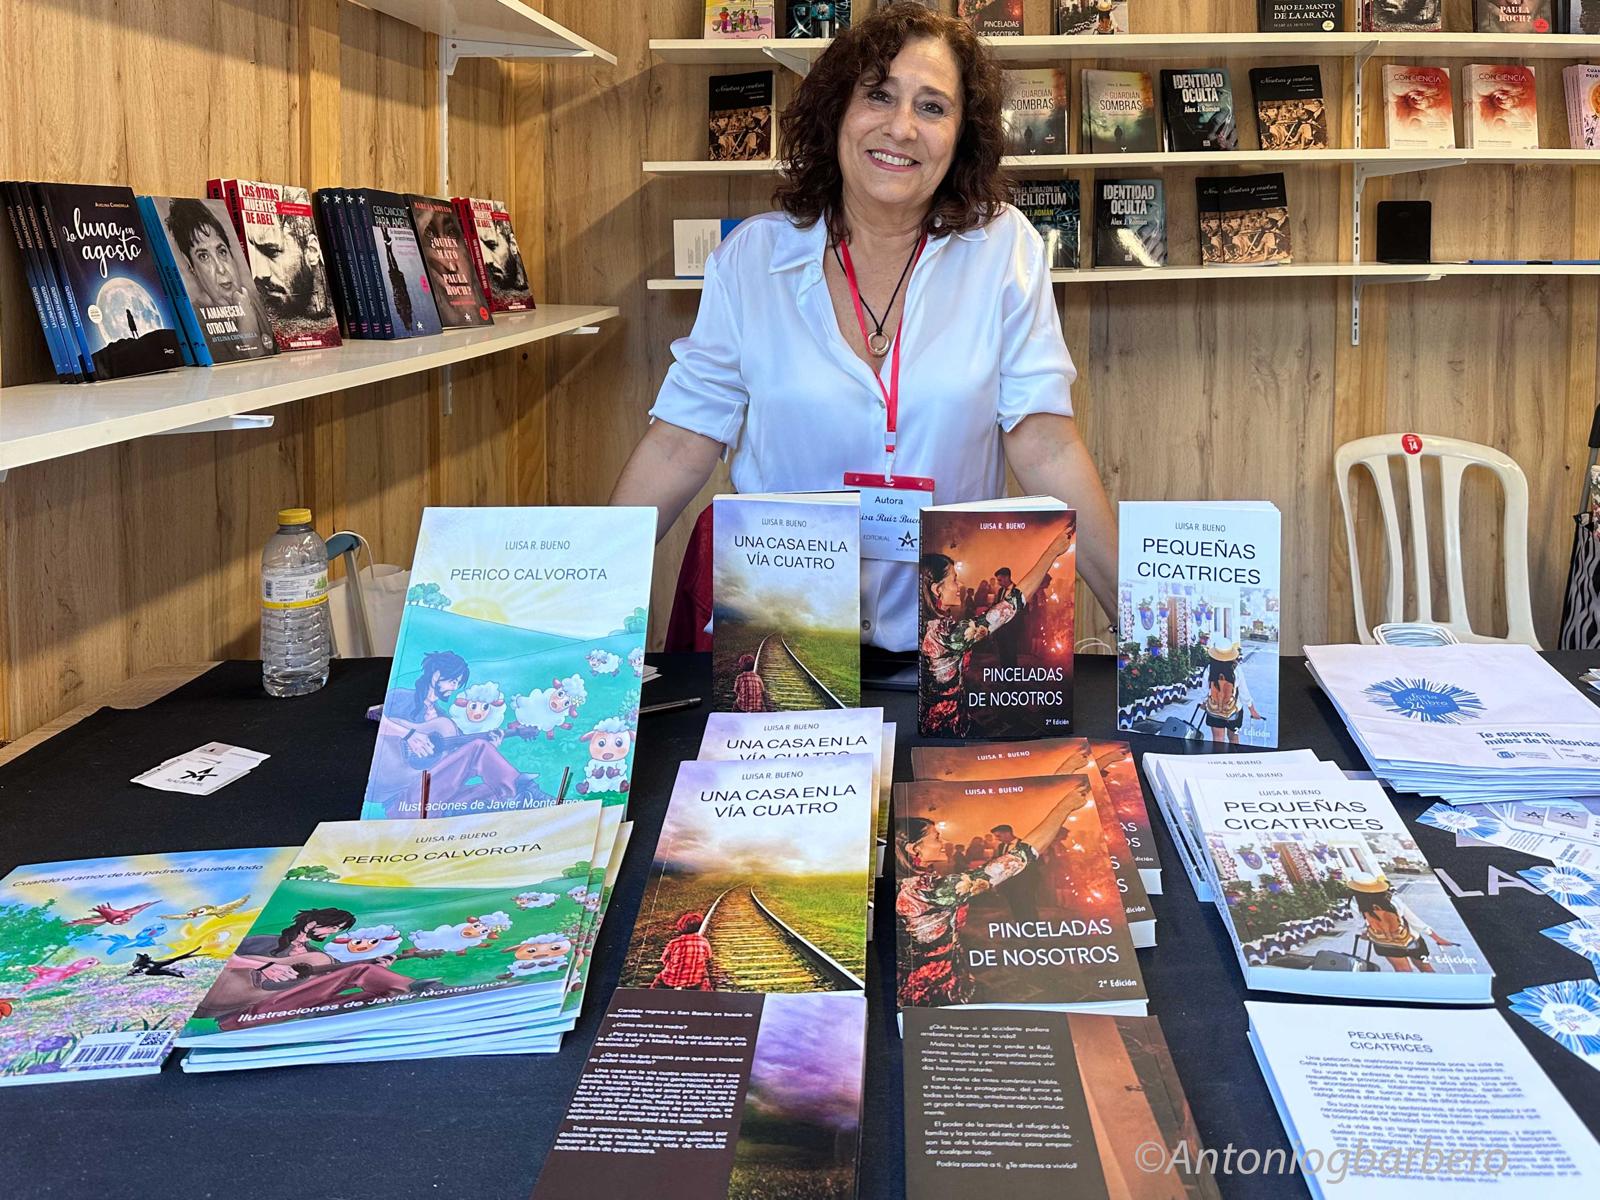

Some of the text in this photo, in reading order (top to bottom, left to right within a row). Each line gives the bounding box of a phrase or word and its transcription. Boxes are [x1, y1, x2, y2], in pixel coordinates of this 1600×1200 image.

[1274, 12, 1287, 20] DE
[1302, 10, 1335, 19] ARAÑA
[1172, 73, 1223, 89] IDENTIDAD
[1394, 72, 1441, 83] CONCIENCIA
[1479, 72, 1527, 83] CONCIENCIA
[1021, 88, 1053, 98] GUARDIÁN
[1109, 90, 1140, 99] GUARDIÁN
[1182, 88, 1218, 103] OCULTA
[1011, 98, 1054, 111] SOMBRAS
[1100, 99, 1143, 111] SOMBRAS
[241, 185, 279, 200] LAS OTRAS
[1014, 192, 1066, 206] HEILIGTUM
[1104, 185, 1154, 200] IDENTIDAD
[244, 198, 277, 212] MUERTES
[1111, 200, 1147, 215] OCULTA
[74, 208, 122, 240] luna
[245, 212, 274, 225] DE ABEL
[431, 236, 458, 249] ¿QUIÉN
[82, 230, 141, 278] agosto
[437, 249, 458, 259] MATÓ
[443, 274, 468, 284] PAULA
[200, 302, 246, 319] Y AMANECERÁ
[206, 318, 238, 334] OTRO DÍA
[874, 496, 903, 504] Autora
[786, 520, 807, 528] BUENO
[876, 513, 897, 522] Ruiz
[899, 515, 920, 524] Buen
[979, 522, 997, 530] LUISA
[1175, 522, 1194, 530] LUISA
[1202, 523, 1226, 532] BUENO
[505, 540, 570, 550] LUISA R. BUENO
[734, 535, 848, 552] UNA CASA EN LA
[1143, 538, 1256, 560] PEQUEÑAS
[747, 552, 835, 570] VÍA CUATRO
[450, 567, 608, 581] PERICO CALVOROTA
[1137, 562, 1261, 585] CICATRICES
[983, 667, 1064, 682] PINCELADAS
[968, 691, 1063, 707] DE NOSOTROS
[763, 724, 784, 732] LUISA
[1244, 728, 1270, 738] Edición
[726, 735, 868, 749] UNA CASA EN LA
[1542, 738, 1600, 747] historias
[1007, 750, 1030, 758] BUENO
[741, 772, 765, 781] LUISA
[775, 771, 804, 779] BUENO
[700, 784, 857, 802] UNA CASA EN LA
[964, 787, 987, 796] LUISA
[998, 786, 1023, 794] BUENO
[398, 799, 468, 812] Ilustaciones
[470, 799, 485, 810] de
[487, 798, 521, 811] Javier
[714, 801, 838, 818] VÍA CUATRO
[1223, 799, 1367, 814] PEQUEÑAS
[1224, 817, 1384, 831] CICATRICES
[415, 835, 445, 844] LUISA
[459, 831, 497, 840] BUENO
[342, 843, 542, 864] PERICO CALVOROTA
[12, 876, 60, 887] Cuando
[144, 868, 185, 878] padres
[198, 865, 236, 873] puede
[988, 918, 1112, 939] PINCELADAS
[969, 946, 1120, 967] DE NOSOTROS
[1435, 954, 1477, 965] Edición
[1110, 978, 1137, 988] Edición
[237, 979, 508, 1023] Ilustraciones de Javier Montesinos
[1347, 1031, 1423, 1042] PEQUEÑAS
[1350, 1041, 1433, 1053] CICATRICES
